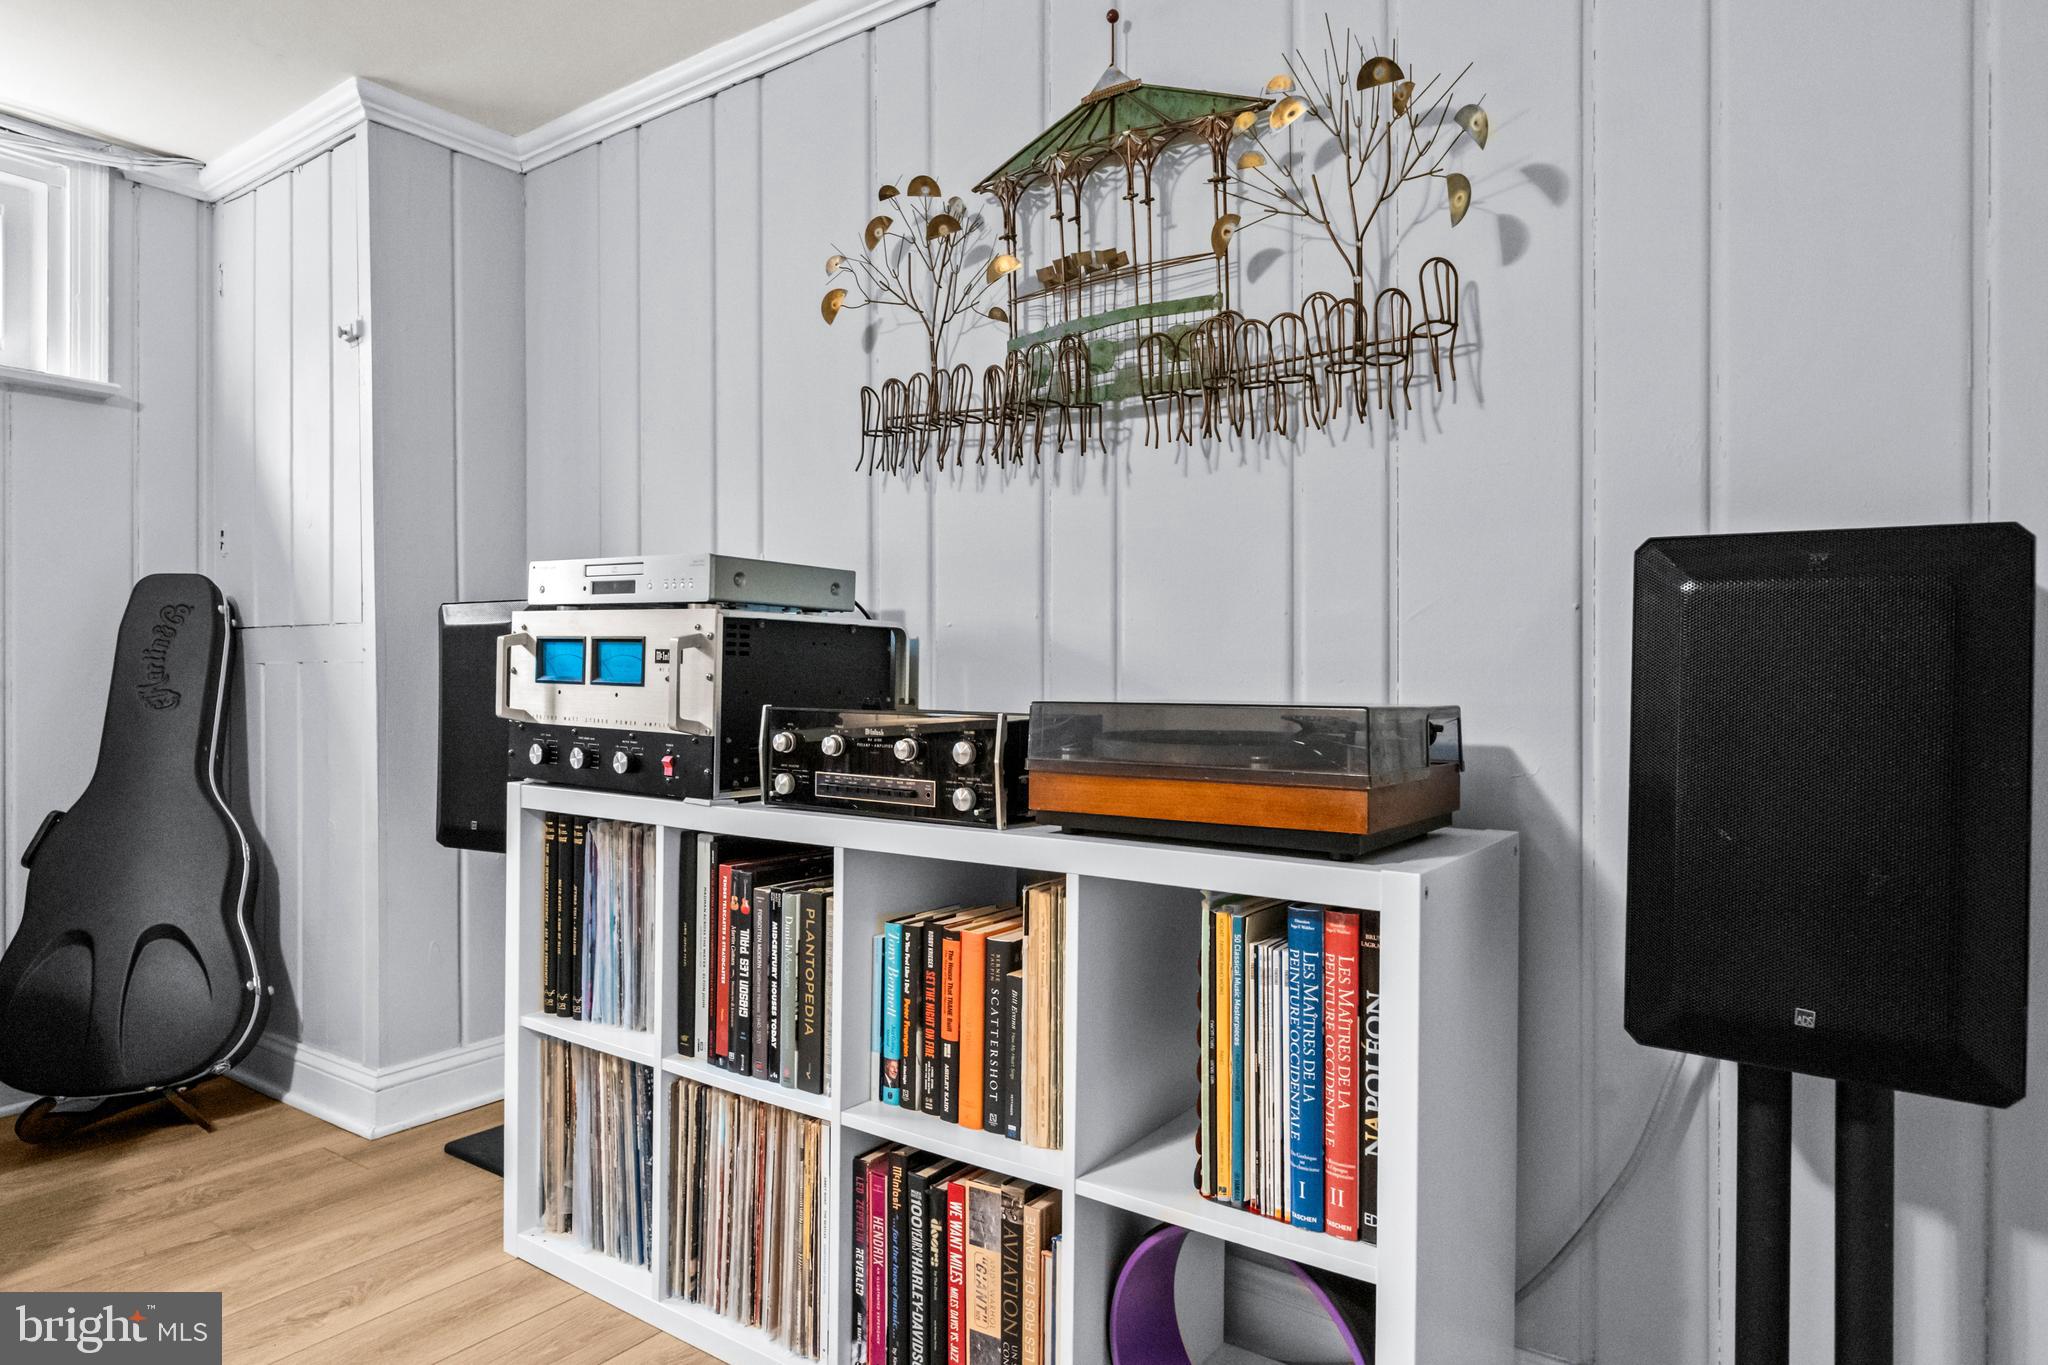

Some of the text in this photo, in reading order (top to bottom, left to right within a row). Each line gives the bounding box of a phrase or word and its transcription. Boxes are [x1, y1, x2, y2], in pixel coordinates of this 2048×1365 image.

[1234, 934, 1242, 943] 50
[738, 929, 750, 1017] GIBSON LES PAUL
[804, 908, 816, 1035] PLANTOPEDIA
[1234, 944, 1242, 975] Classical
[926, 970, 935, 986] SET
[925, 987, 935, 1001] THE
[925, 1004, 935, 1027] NIGHT
[1233, 999, 1241, 1046] Masterpieces
[1303, 950, 1319, 1103] LES MAÎTRES DE LA
[925, 1028, 935, 1040] ON
[989, 988, 1000, 1102] SCATTERSHOT
[1289, 948, 1300, 1141] PEINTURE OCCIDENTALE
[1338, 955, 1355, 1109] LES MAÎTRES DE LA
[925, 1042, 935, 1058] FIRE
[1325, 952, 1335, 1147] PEINTURE OCCIDENTALE
[892, 1166, 902, 1210] McIntosh
[1298, 1181, 1305, 1199] I
[1330, 1187, 1344, 1208] II
[911, 1199, 922, 1228] 100
[950, 1201, 962, 1216] WE
[1291, 1211, 1317, 1224] TASCHEN
[855, 1177, 864, 1296] LED ZEPPELIN REVEALED
[911, 1228, 922, 1252] YEARS
[950, 1220, 963, 1250] WANT
[1326, 1219, 1352, 1233] TASCHEN
[872, 1216, 884, 1267] HENDRIX
[930, 1218, 942, 1267] doors
[950, 1252, 963, 1285] MILES
[1003, 1226, 1018, 1337] AVIATION
[892, 1286, 899, 1298] of
[950, 1287, 959, 1309] MILES
[1024, 1216, 1036, 1361] LES ROIS DE FRANCE
[950, 1309, 958, 1331] DAVIS
[950, 1343, 958, 1363] JAZZ
[1011, 1345, 1018, 1359] UN
